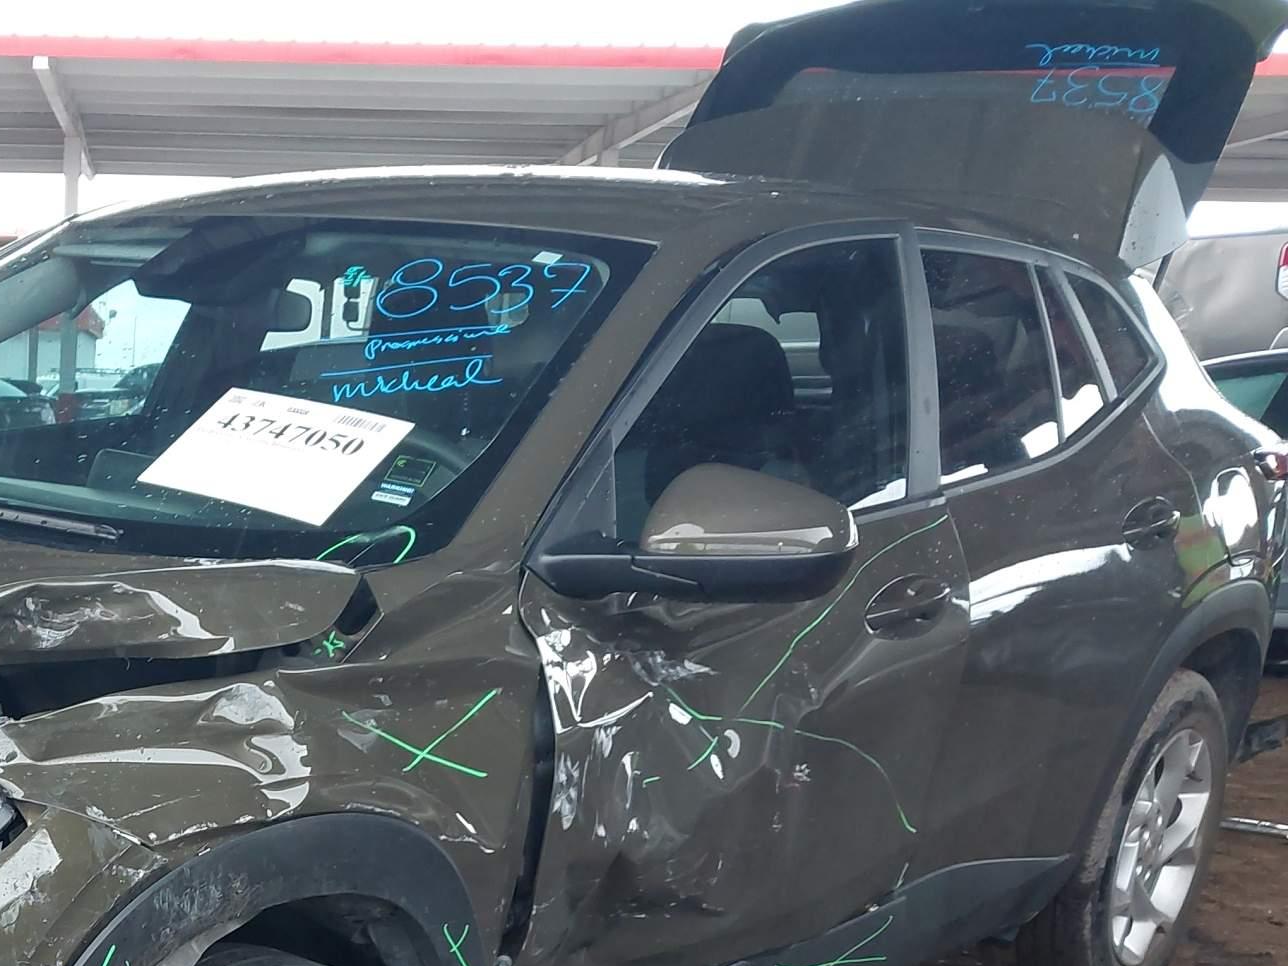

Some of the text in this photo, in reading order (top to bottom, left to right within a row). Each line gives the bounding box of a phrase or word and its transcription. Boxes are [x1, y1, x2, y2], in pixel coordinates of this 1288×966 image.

[1031, 66, 1163, 113] 8537
[376, 258, 592, 318] 8537
[217, 412, 365, 456] 43747050
